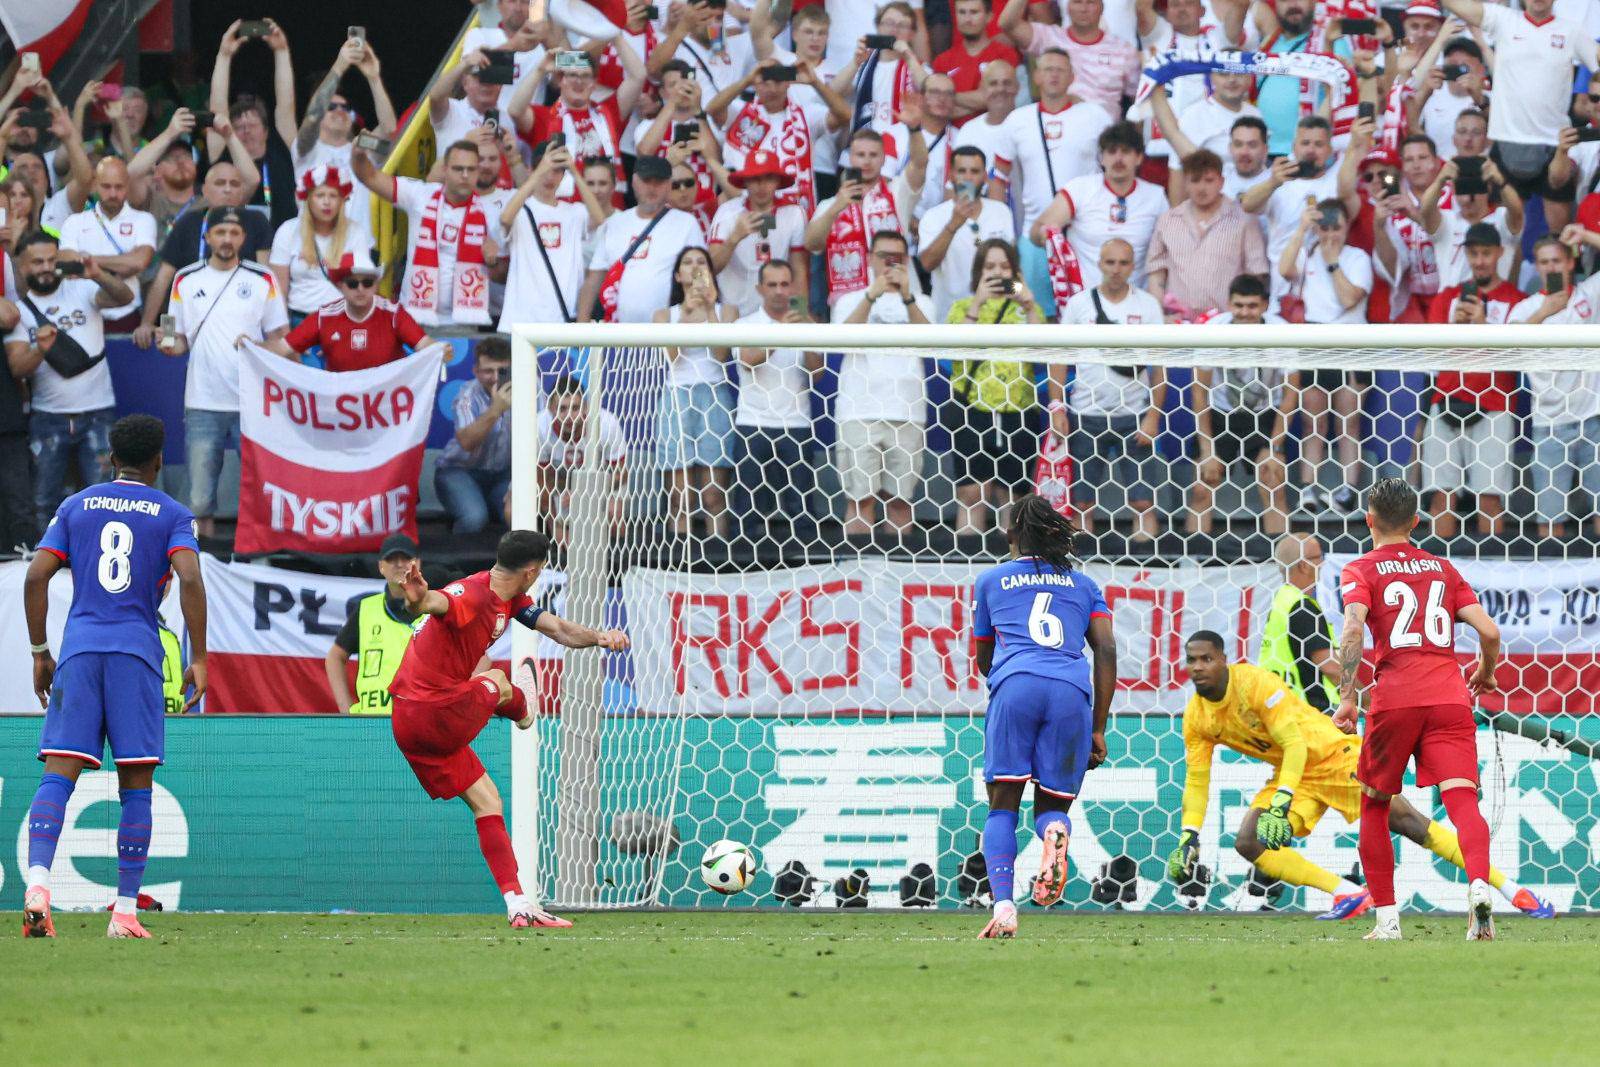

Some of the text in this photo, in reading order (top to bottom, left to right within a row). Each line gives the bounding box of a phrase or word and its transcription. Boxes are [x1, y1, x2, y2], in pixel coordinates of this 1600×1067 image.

[263, 376, 415, 431] POLSKA
[82, 496, 161, 516] TCHOUAMENI
[262, 480, 410, 538] TYSKIE
[97, 521, 134, 594] 8
[1000, 573, 1075, 590] CAMAVINGA
[1375, 558, 1443, 575] URBAŃSKI
[667, 580, 863, 698] RKS
[1027, 591, 1065, 650] 6
[1383, 580, 1452, 649] 26
